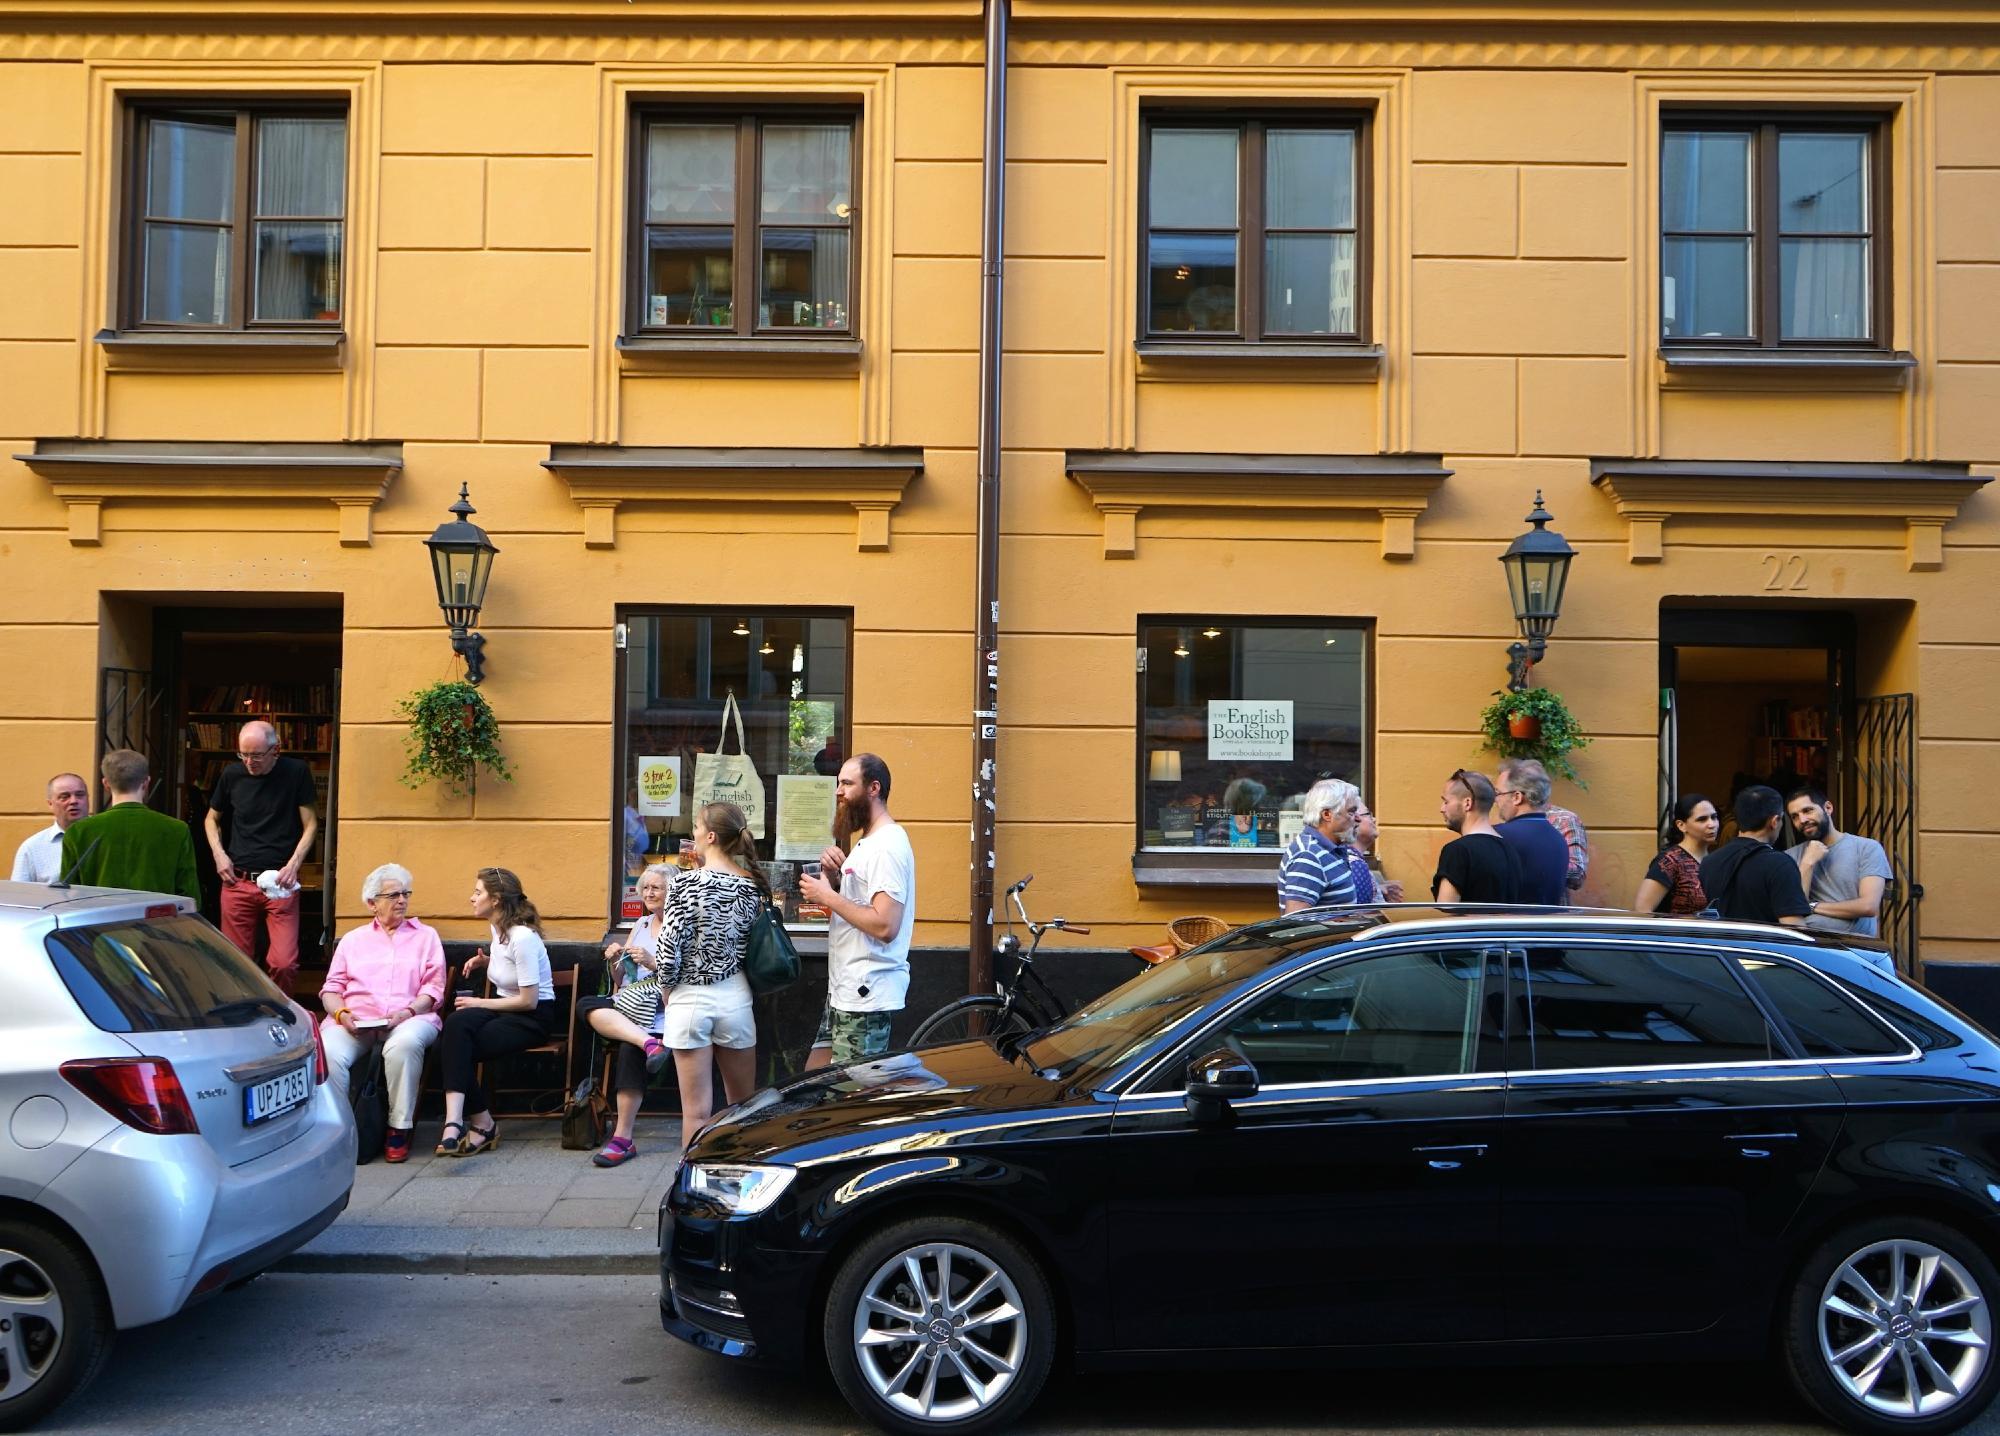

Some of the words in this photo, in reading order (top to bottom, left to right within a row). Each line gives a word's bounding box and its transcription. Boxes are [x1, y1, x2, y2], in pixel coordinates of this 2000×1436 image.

[1761, 554, 1808, 591] 22
[1227, 708, 1285, 728] English
[1212, 723, 1289, 744] Bookshop
[643, 772, 649, 782] 3
[652, 770, 663, 783] for
[666, 769, 672, 780] 2
[712, 790, 752, 801] English
[257, 1081, 281, 1112] UPZ
[284, 1072, 304, 1102] 285
